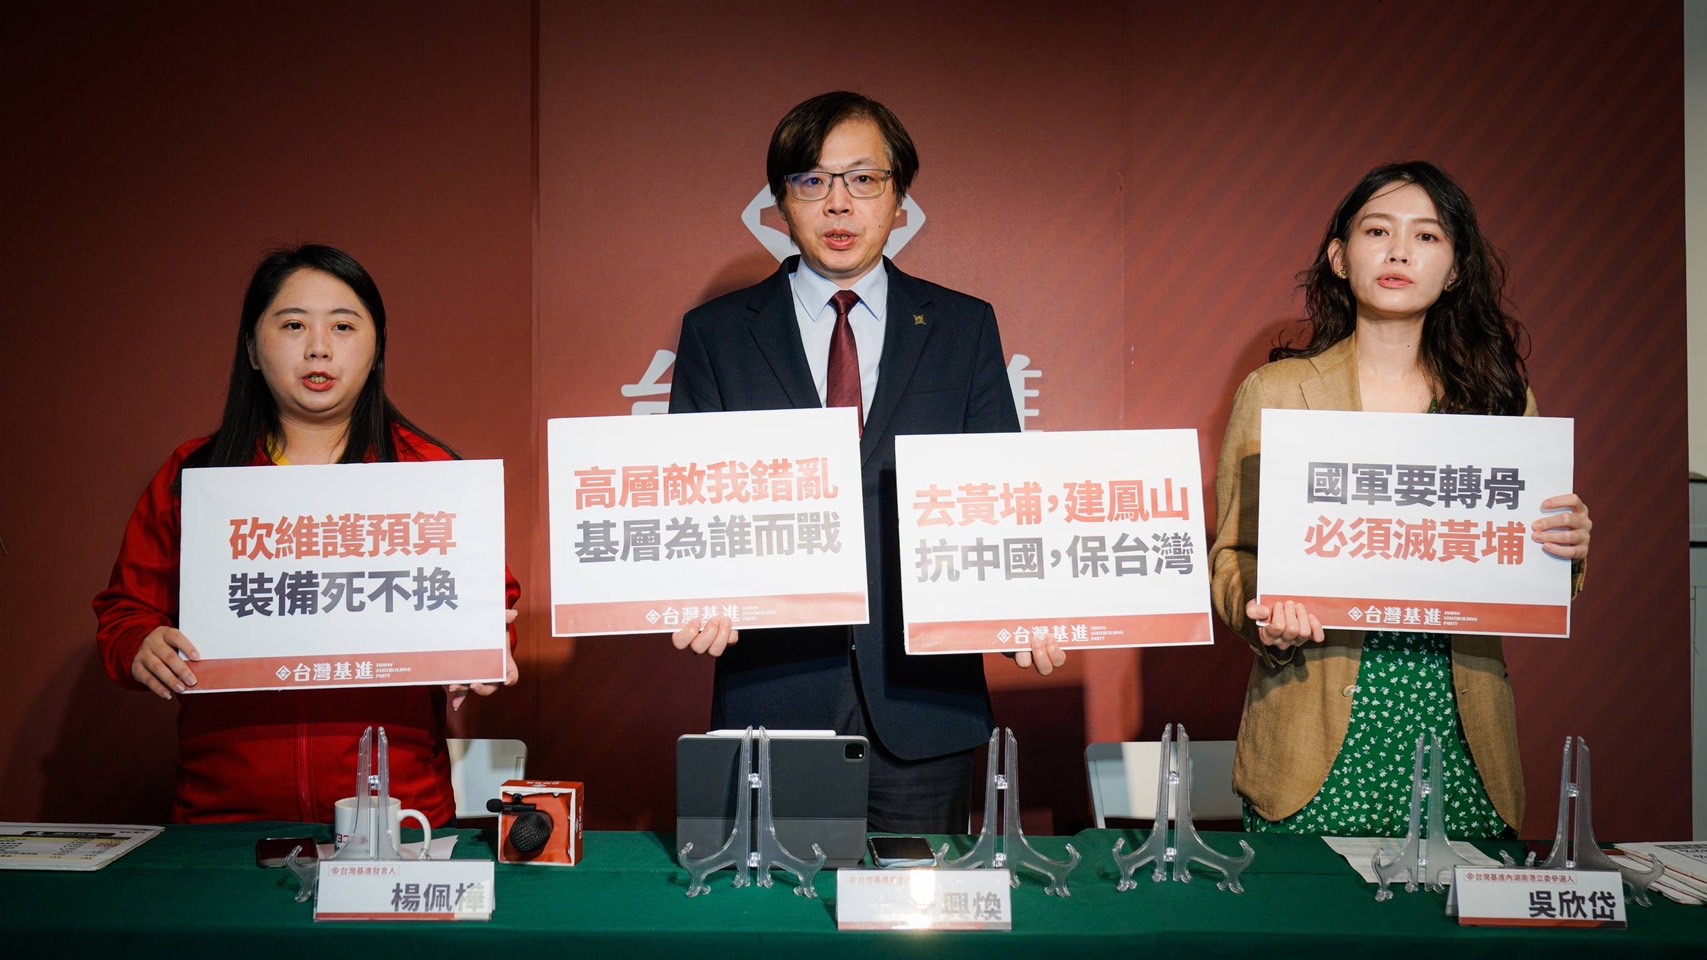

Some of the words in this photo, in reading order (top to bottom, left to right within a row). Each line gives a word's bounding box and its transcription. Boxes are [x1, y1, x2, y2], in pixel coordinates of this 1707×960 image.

[574, 457, 839, 510] 高層敵我錯亂
[1307, 462, 1525, 510] 國軍要轉骨
[229, 511, 457, 561] 砍維護預算
[574, 511, 842, 563] 基層為誰而戰
[1304, 515, 1526, 565] 必須滅黃埔
[228, 567, 458, 618] 裝備死不換
[1365, 605, 1441, 625] 台灣基進
[293, 661, 373, 681] 台灣基進
[391, 882, 485, 912] 楊佩樺
[1529, 890, 1617, 920] 吳欣岱
